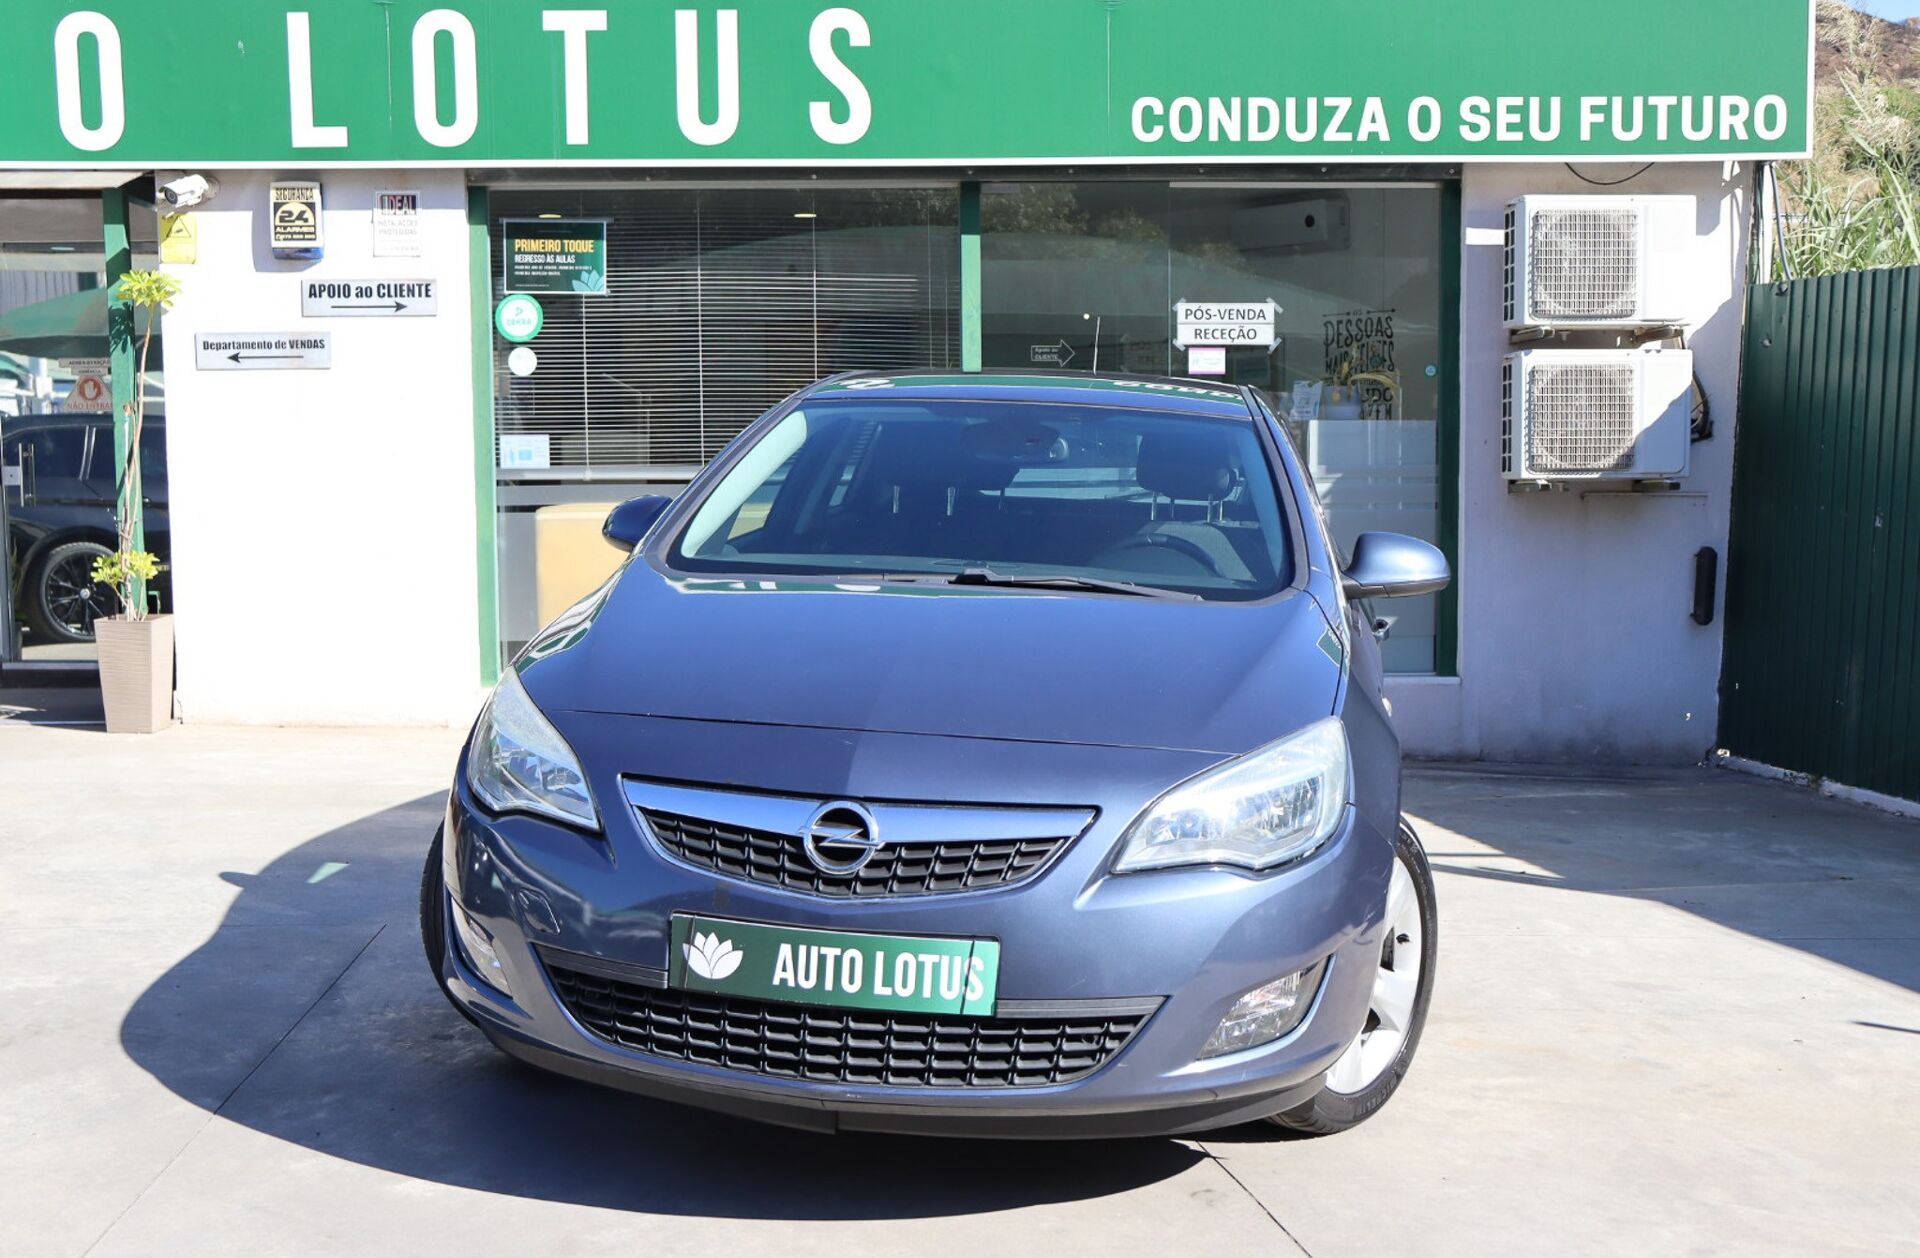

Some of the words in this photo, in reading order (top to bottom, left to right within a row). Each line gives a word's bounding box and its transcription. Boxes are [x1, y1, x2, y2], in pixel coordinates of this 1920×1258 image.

[287, 8, 871, 147] LOTUS
[1132, 97, 1389, 142] CONDUZA
[1408, 97, 1440, 141] O
[1460, 96, 1560, 141] SEU
[1581, 95, 1786, 140] FUTURO
[381, 195, 417, 215] IDEAL
[279, 210, 309, 223] 24
[514, 239, 561, 252] PRIMEIRO
[564, 240, 594, 253] TOQUE
[514, 254, 545, 263] REGRESSO
[546, 253, 555, 263] ÀS
[555, 255, 575, 263] AULAS
[308, 283, 351, 299] APOIO
[355, 286, 373, 298] ao
[376, 283, 432, 298] CLIENTE
[1185, 306, 1267, 320] PÓS-VENDA
[1194, 326, 1257, 343] RECEÇÃO
[1323, 316, 1394, 358] PESSOAS
[202, 340, 273, 352] Departamento
[274, 340, 287, 350] de
[288, 339, 325, 349] VENDAS
[773, 943, 863, 993] AUTO
[874, 951, 986, 1002] LOTUS
